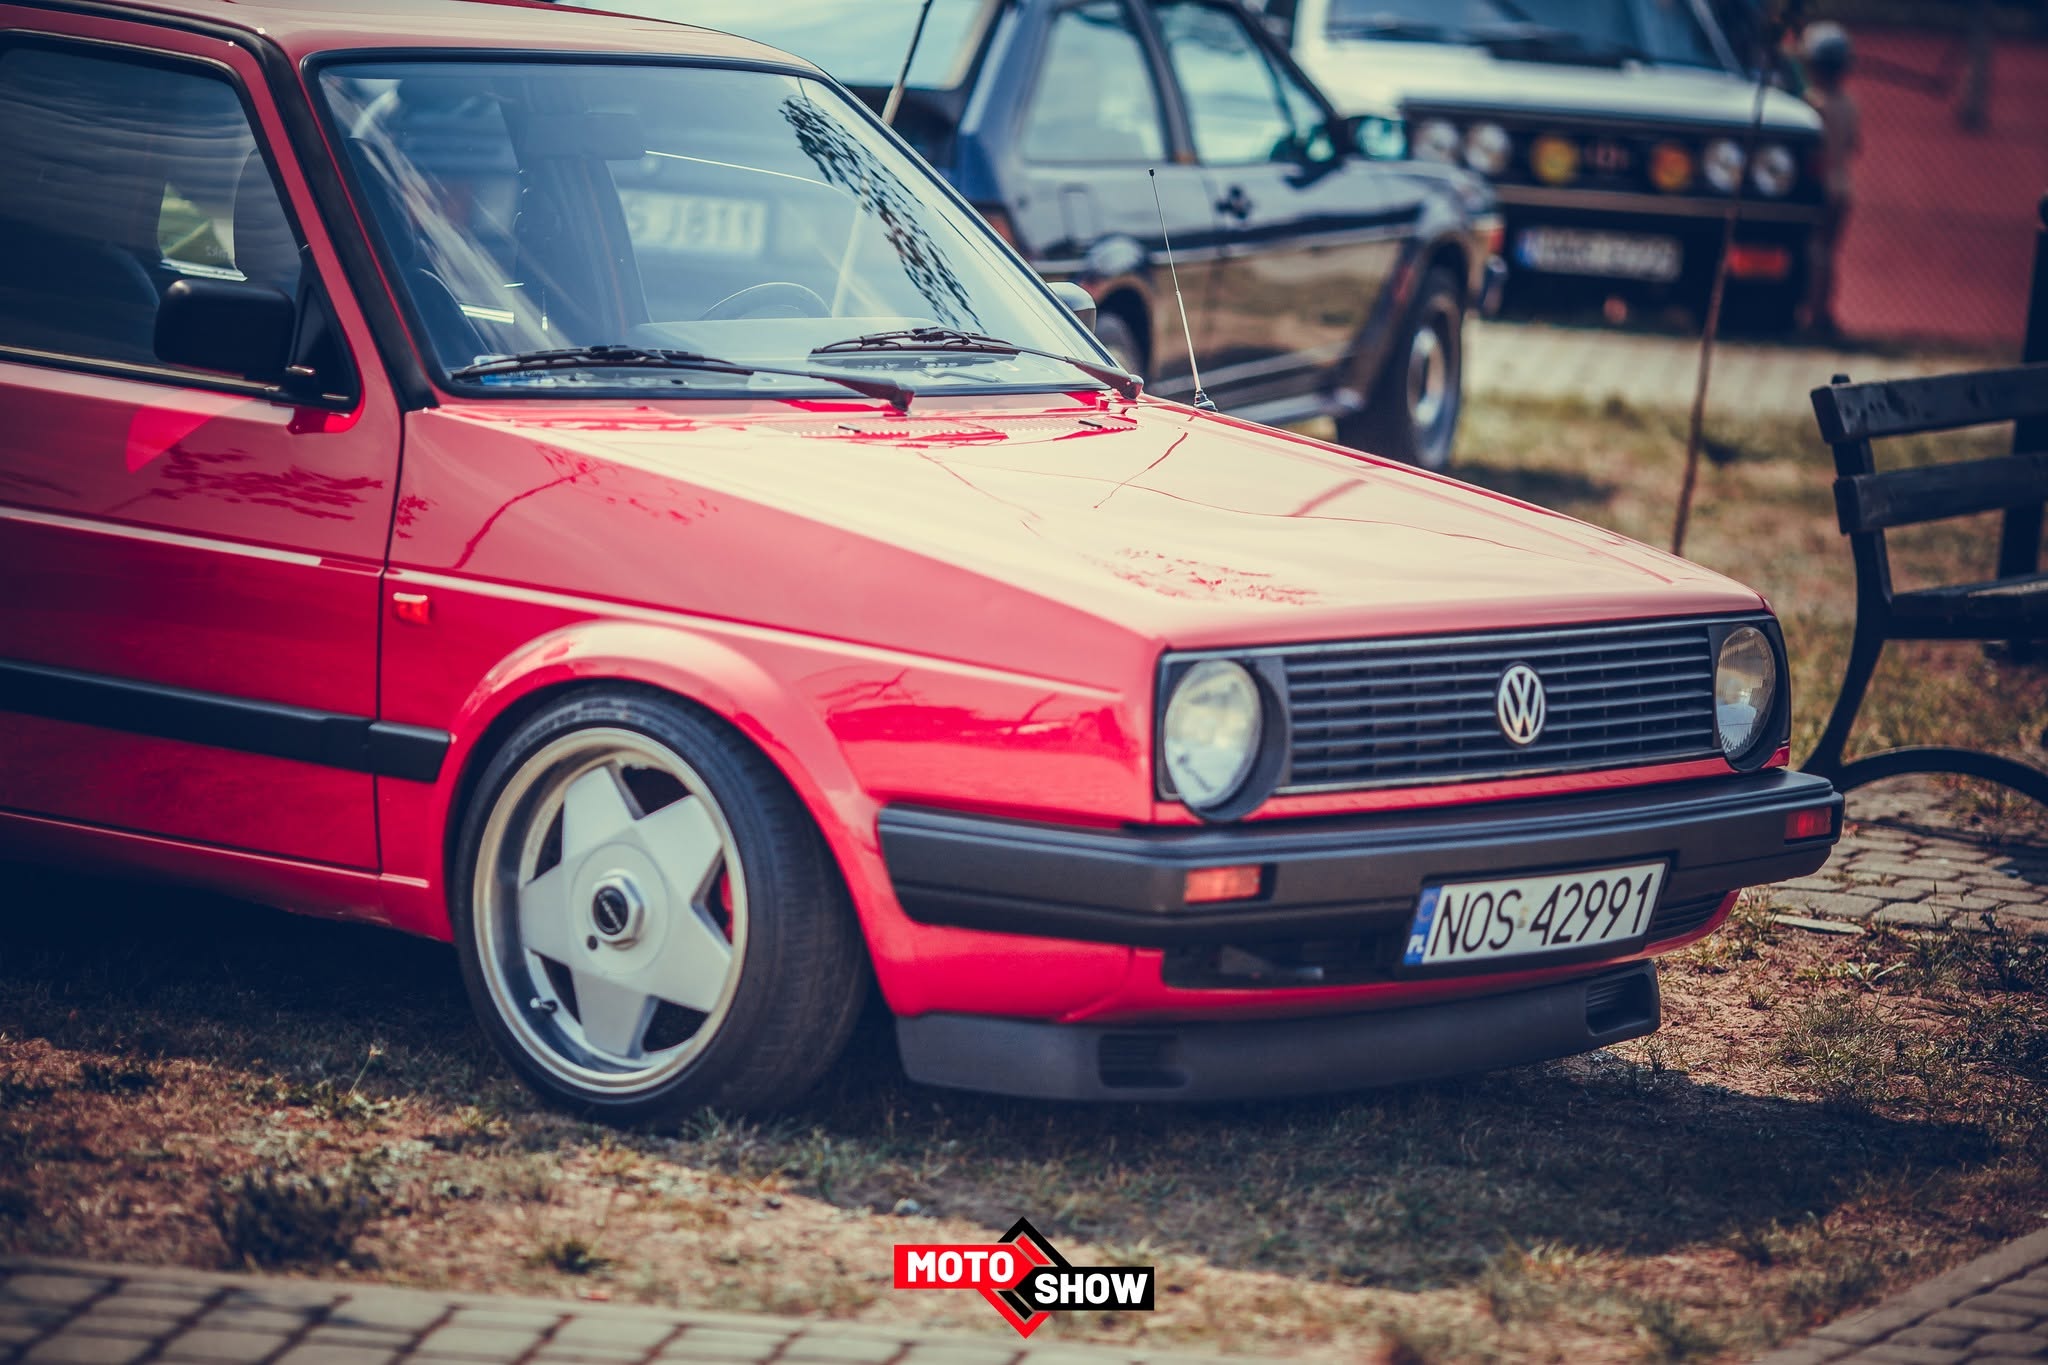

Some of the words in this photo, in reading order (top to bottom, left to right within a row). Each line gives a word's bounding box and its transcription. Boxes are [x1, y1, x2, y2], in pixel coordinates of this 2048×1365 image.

[1499, 666, 1545, 744] VW
[1430, 889, 1522, 957] NOS
[1529, 872, 1654, 946] 42991
